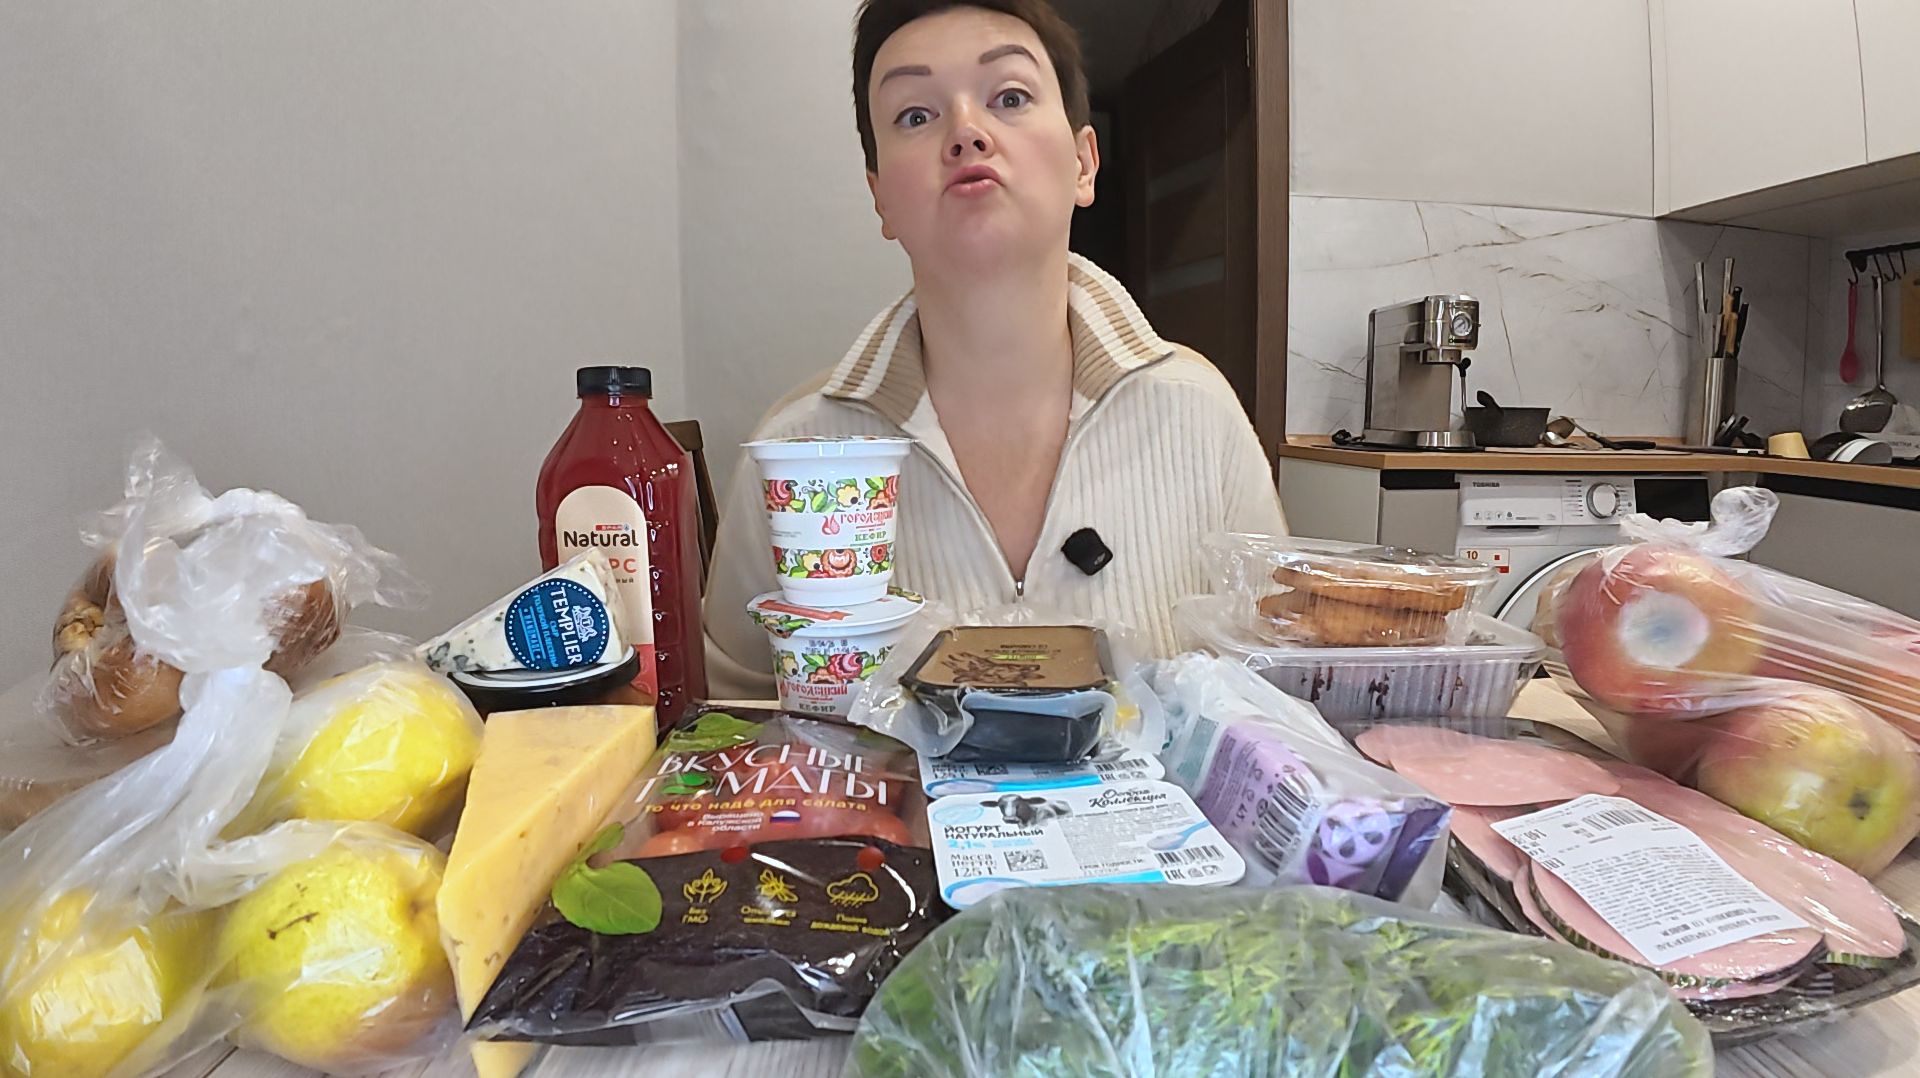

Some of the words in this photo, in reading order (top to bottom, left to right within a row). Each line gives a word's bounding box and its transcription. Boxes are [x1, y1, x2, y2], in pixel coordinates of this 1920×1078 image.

[563, 529, 640, 548] Natural
[855, 530, 887, 542] КЕФИР
[1466, 551, 1479, 560] 10
[550, 586, 583, 665] TEMPLIER
[798, 703, 836, 713] КЕФИР
[645, 805, 663, 813] то
[670, 802, 701, 811] что
[760, 797, 796, 808] для
[803, 799, 867, 811] салата
[1089, 793, 1166, 808] Коллекция
[944, 824, 1001, 834] ЙОГУРТ
[945, 828, 1044, 840] НАТУРАЛЬНЫЙ
[951, 853, 992, 861] Масса
[681, 913, 709, 924] ГМО
